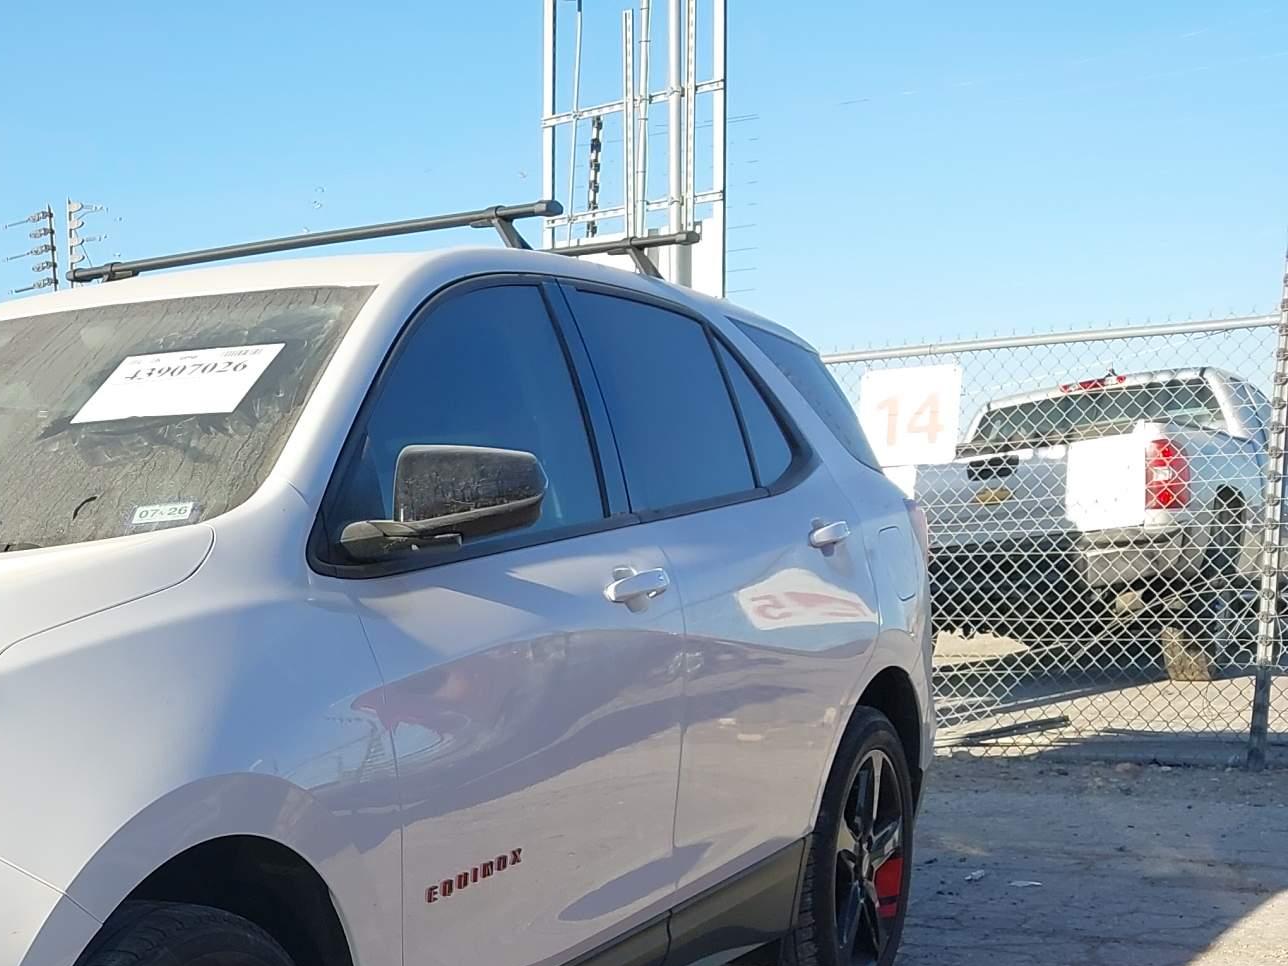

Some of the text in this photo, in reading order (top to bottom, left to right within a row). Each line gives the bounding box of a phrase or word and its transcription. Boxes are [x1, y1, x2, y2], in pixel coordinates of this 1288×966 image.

[124, 360, 248, 381] 43907026
[876, 393, 944, 446] 14
[425, 848, 523, 903] EQUINOX
